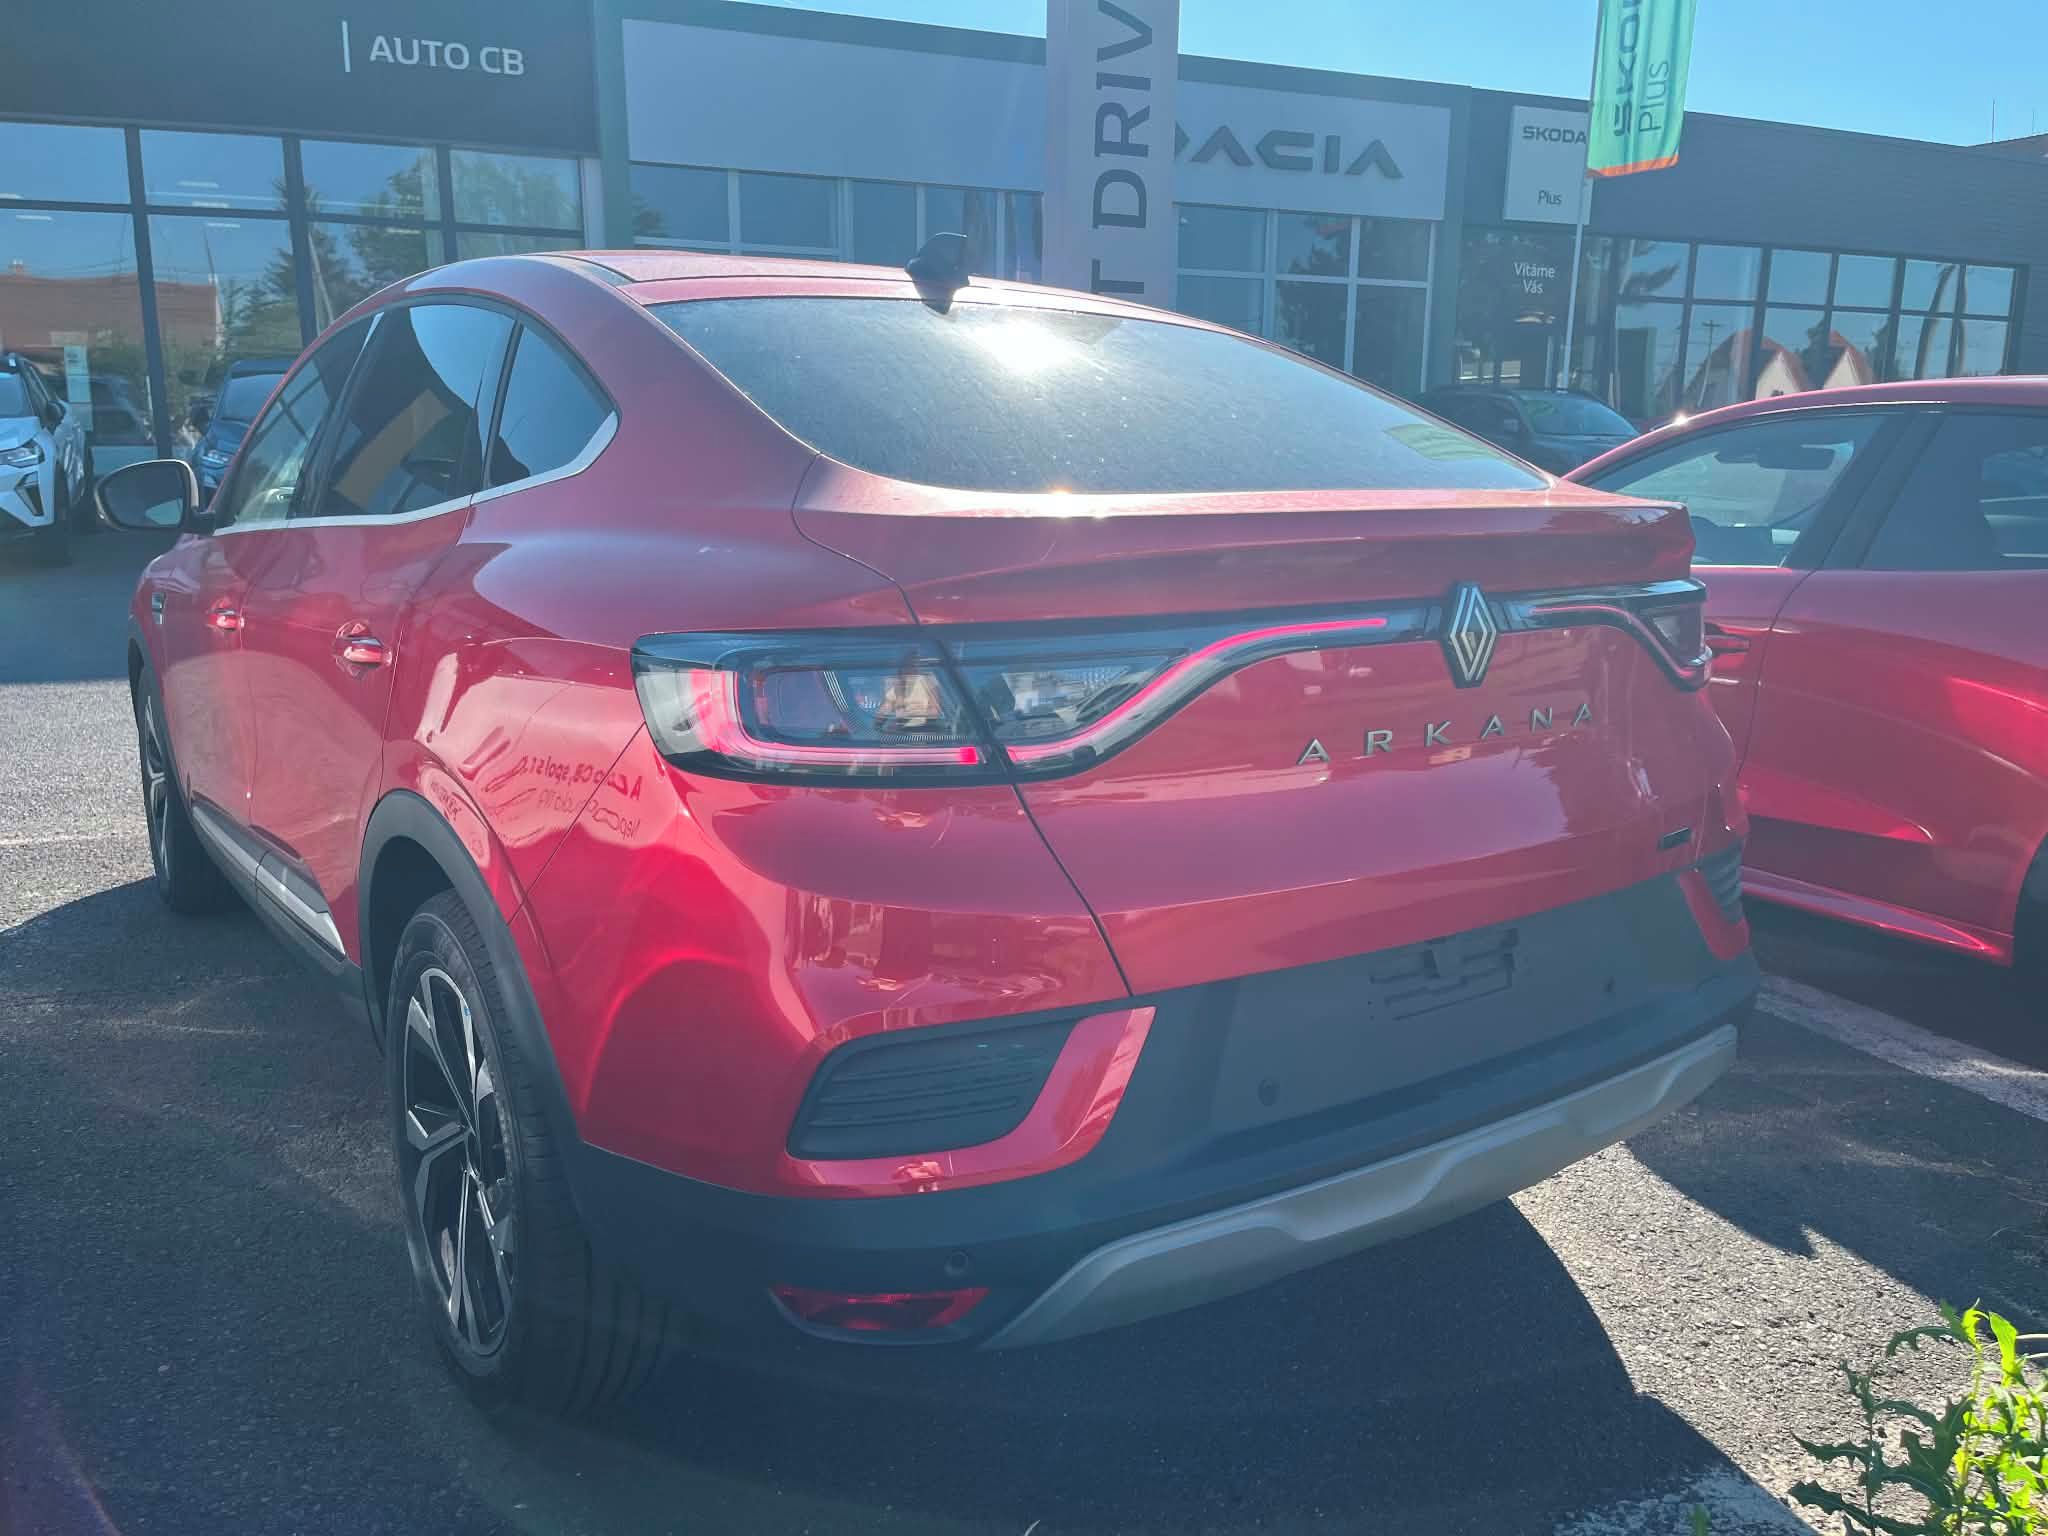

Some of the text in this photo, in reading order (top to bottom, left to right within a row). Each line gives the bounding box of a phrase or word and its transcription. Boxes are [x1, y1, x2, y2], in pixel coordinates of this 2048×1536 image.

[370, 35, 525, 76] AUTO CB
[1638, 60, 1670, 133] Plus
[1537, 189, 1563, 205] Plus
[1522, 278, 1544, 295] Vás
[1297, 703, 1594, 765] ARKANA
